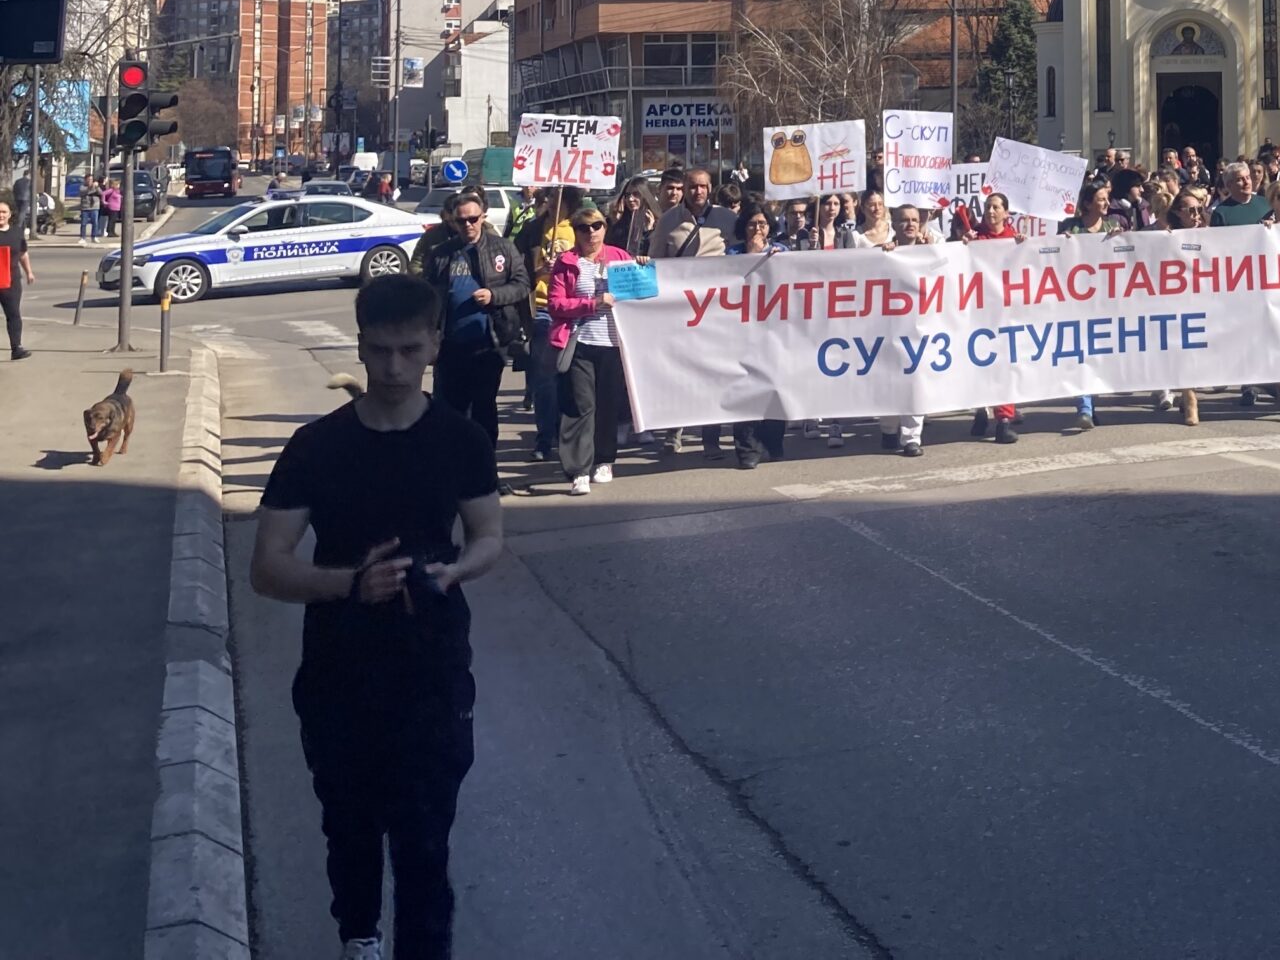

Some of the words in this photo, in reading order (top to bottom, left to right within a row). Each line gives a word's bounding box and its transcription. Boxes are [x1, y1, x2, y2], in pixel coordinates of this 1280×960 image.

[646, 103, 732, 116] APOTEKA
[540, 119, 598, 135] SISTEM
[645, 119, 687, 128] HERBA
[689, 118, 733, 127] PHARM
[561, 134, 579, 147] TE
[533, 147, 594, 184] LAŽE
[817, 159, 856, 190] НЕ
[253, 245, 340, 259] ПОЛИЦИЈА
[684, 275, 945, 327] УЧИТЕЉИ
[958, 271, 984, 311] И
[817, 336, 885, 377] СУ
[901, 332, 952, 375] УЗ
[967, 312, 1208, 367] СТУДЕНТЕ
